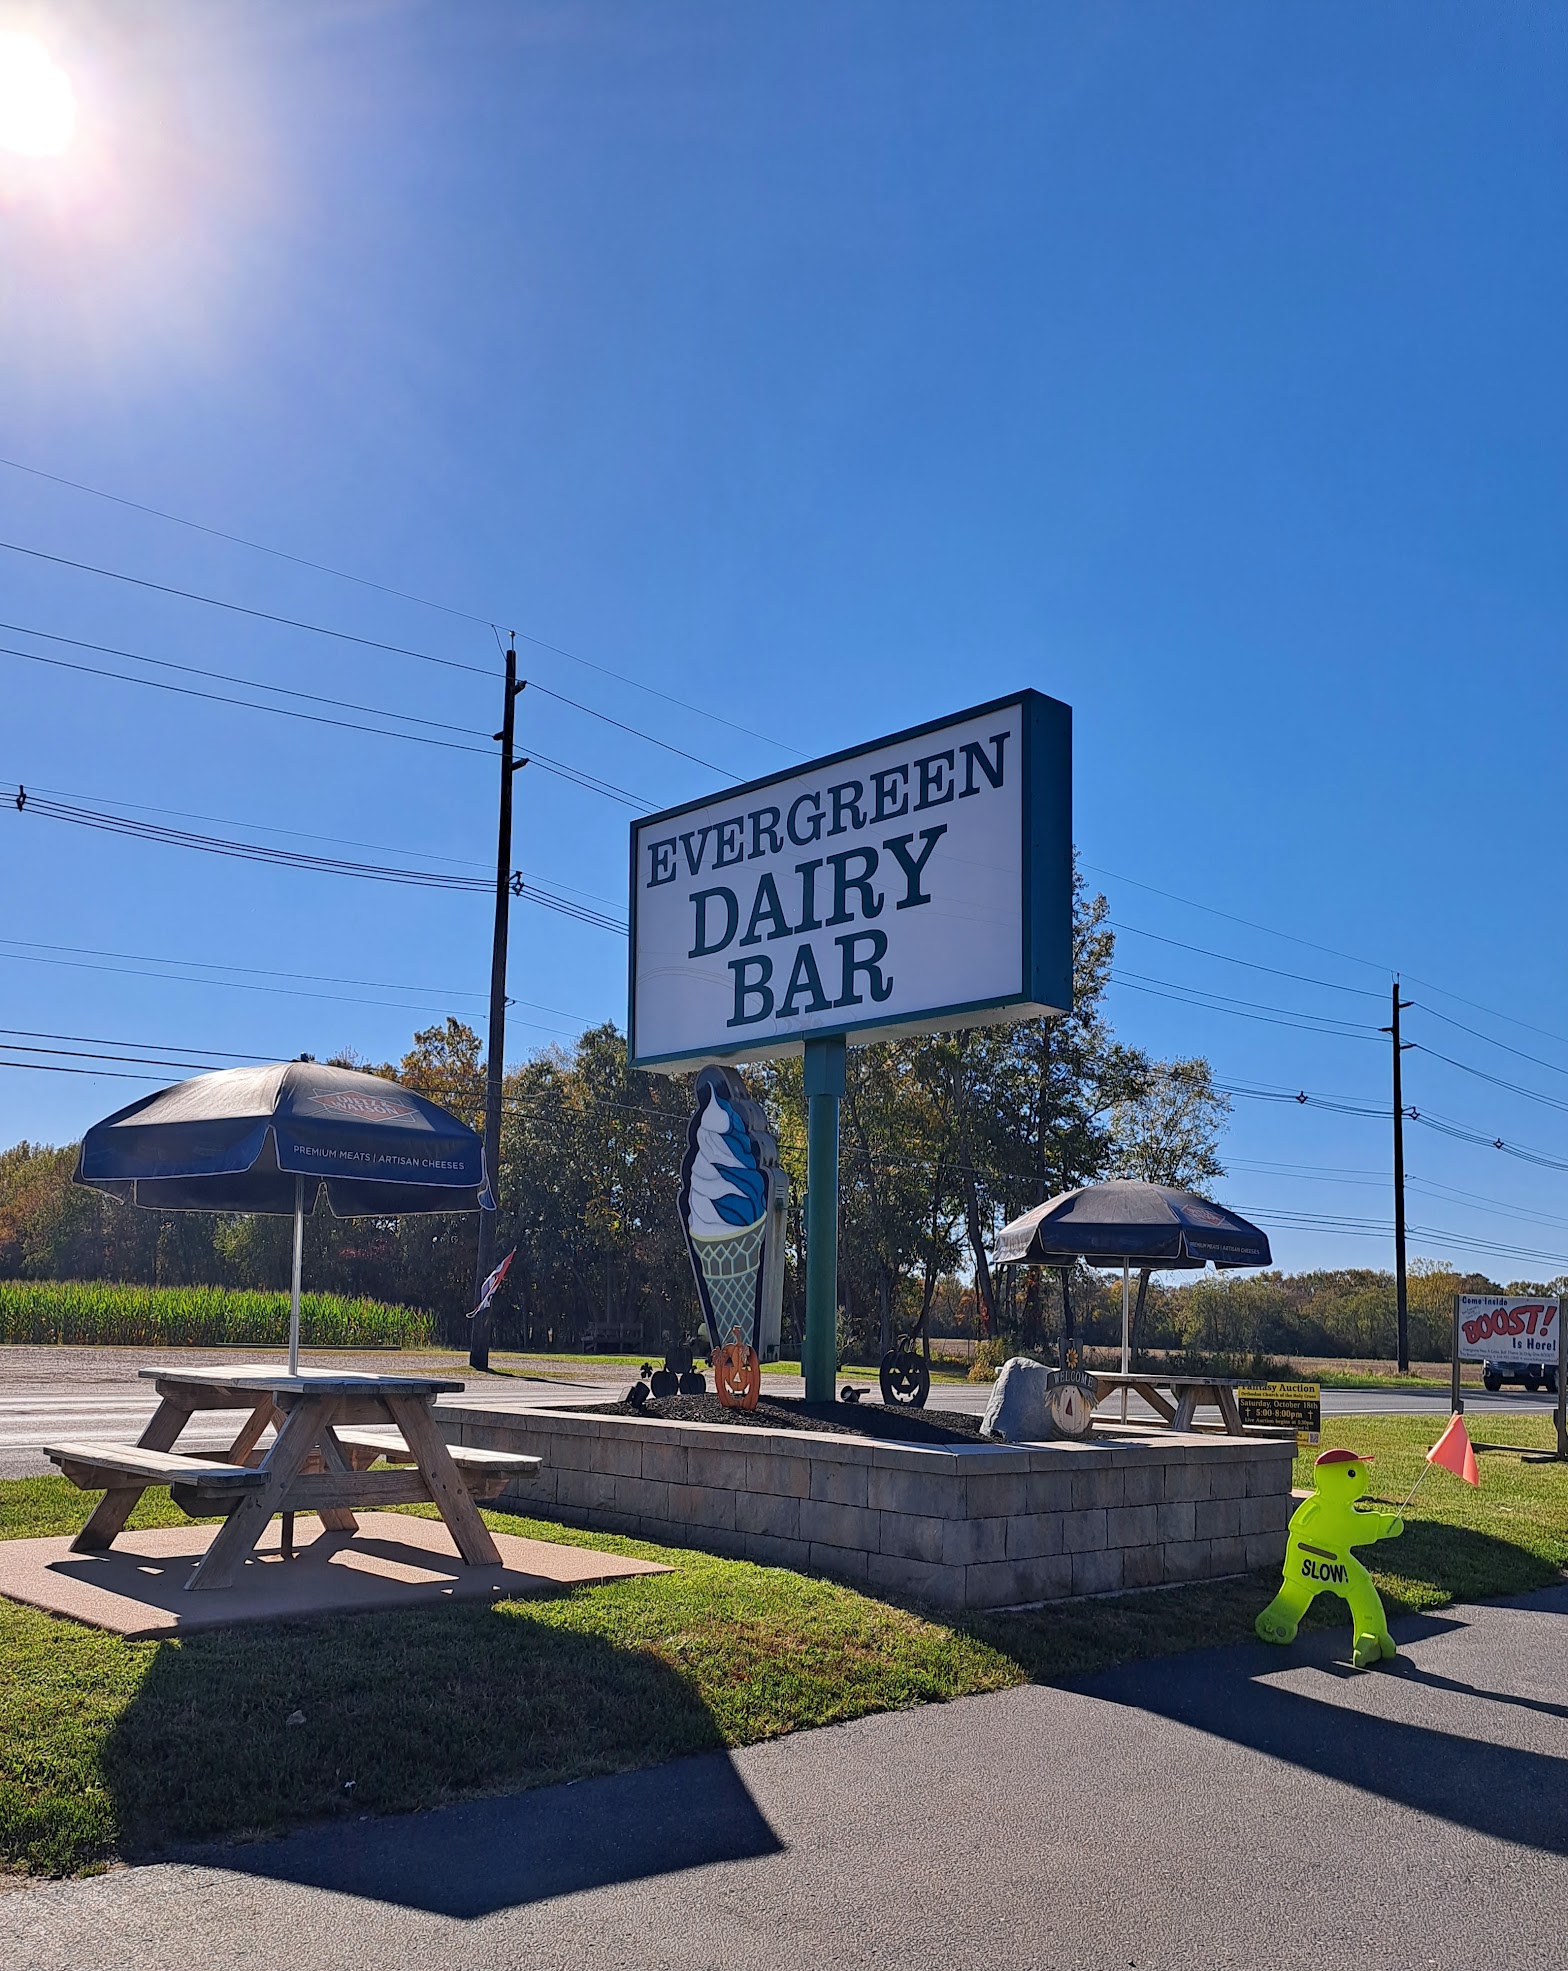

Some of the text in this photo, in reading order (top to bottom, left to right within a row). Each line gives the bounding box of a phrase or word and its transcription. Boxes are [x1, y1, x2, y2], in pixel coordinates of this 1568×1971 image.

[646, 731, 1011, 888] EVERGREEN
[688, 824, 948, 959] DAIRY
[726, 929, 894, 1028] BAR
[331, 1100, 399, 1115] WATSON
[336, 1095, 379, 1107] DIETZ
[293, 1145, 337, 1158] PREMIUM
[340, 1151, 371, 1162] MEATS
[378, 1155, 420, 1167] ARTISAN
[421, 1159, 465, 1170] CHEESES
[1462, 1296, 1508, 1306] Come Inside
[1462, 1305, 1557, 1344] BOOST!
[1512, 1337, 1522, 1349] Is
[1054, 1371, 1094, 1387] WELCOME
[1280, 1384, 1315, 1392] Auction
[1240, 1399, 1318, 1409] Saturday, October 18th
[1301, 1558, 1349, 1584] SLOW!
